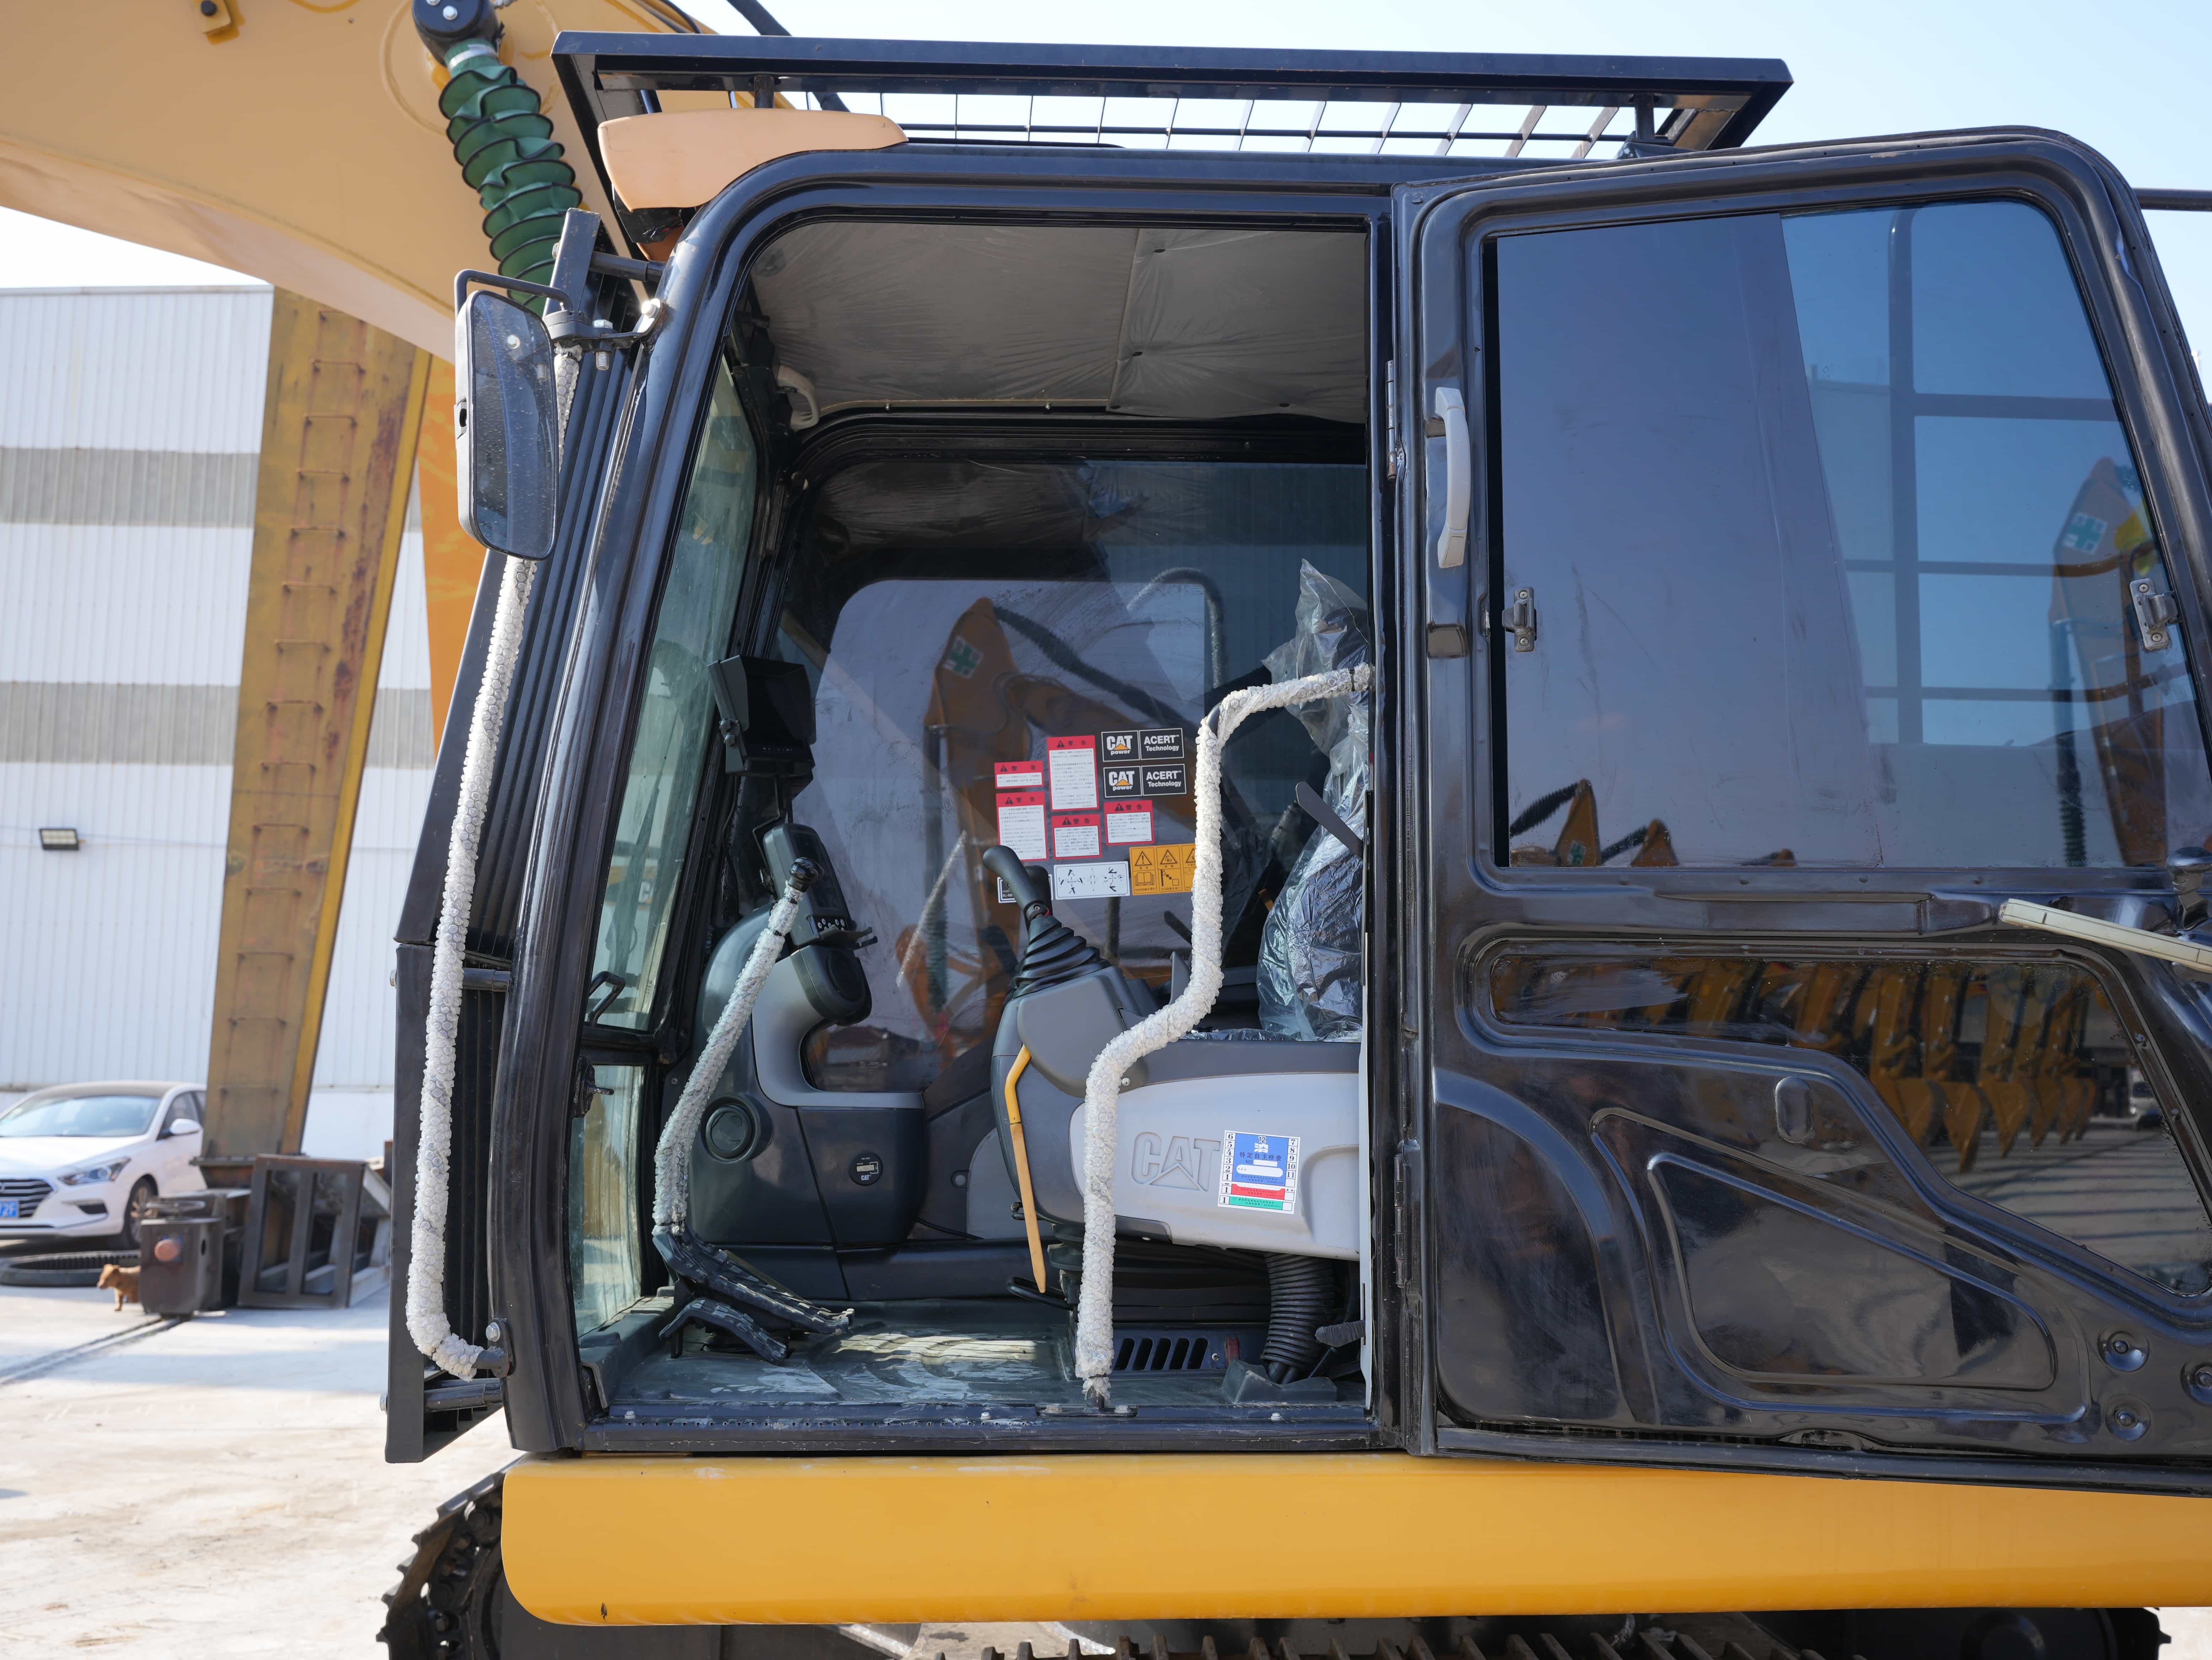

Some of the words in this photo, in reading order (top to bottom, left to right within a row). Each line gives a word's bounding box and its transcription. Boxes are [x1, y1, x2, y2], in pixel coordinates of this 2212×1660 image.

[1106, 735, 1133, 751] CAT
[1108, 771, 1135, 786] CAT
[1132, 1132, 1220, 1191] CAT
[1239, 1152, 1282, 1162] 特定自主検査
